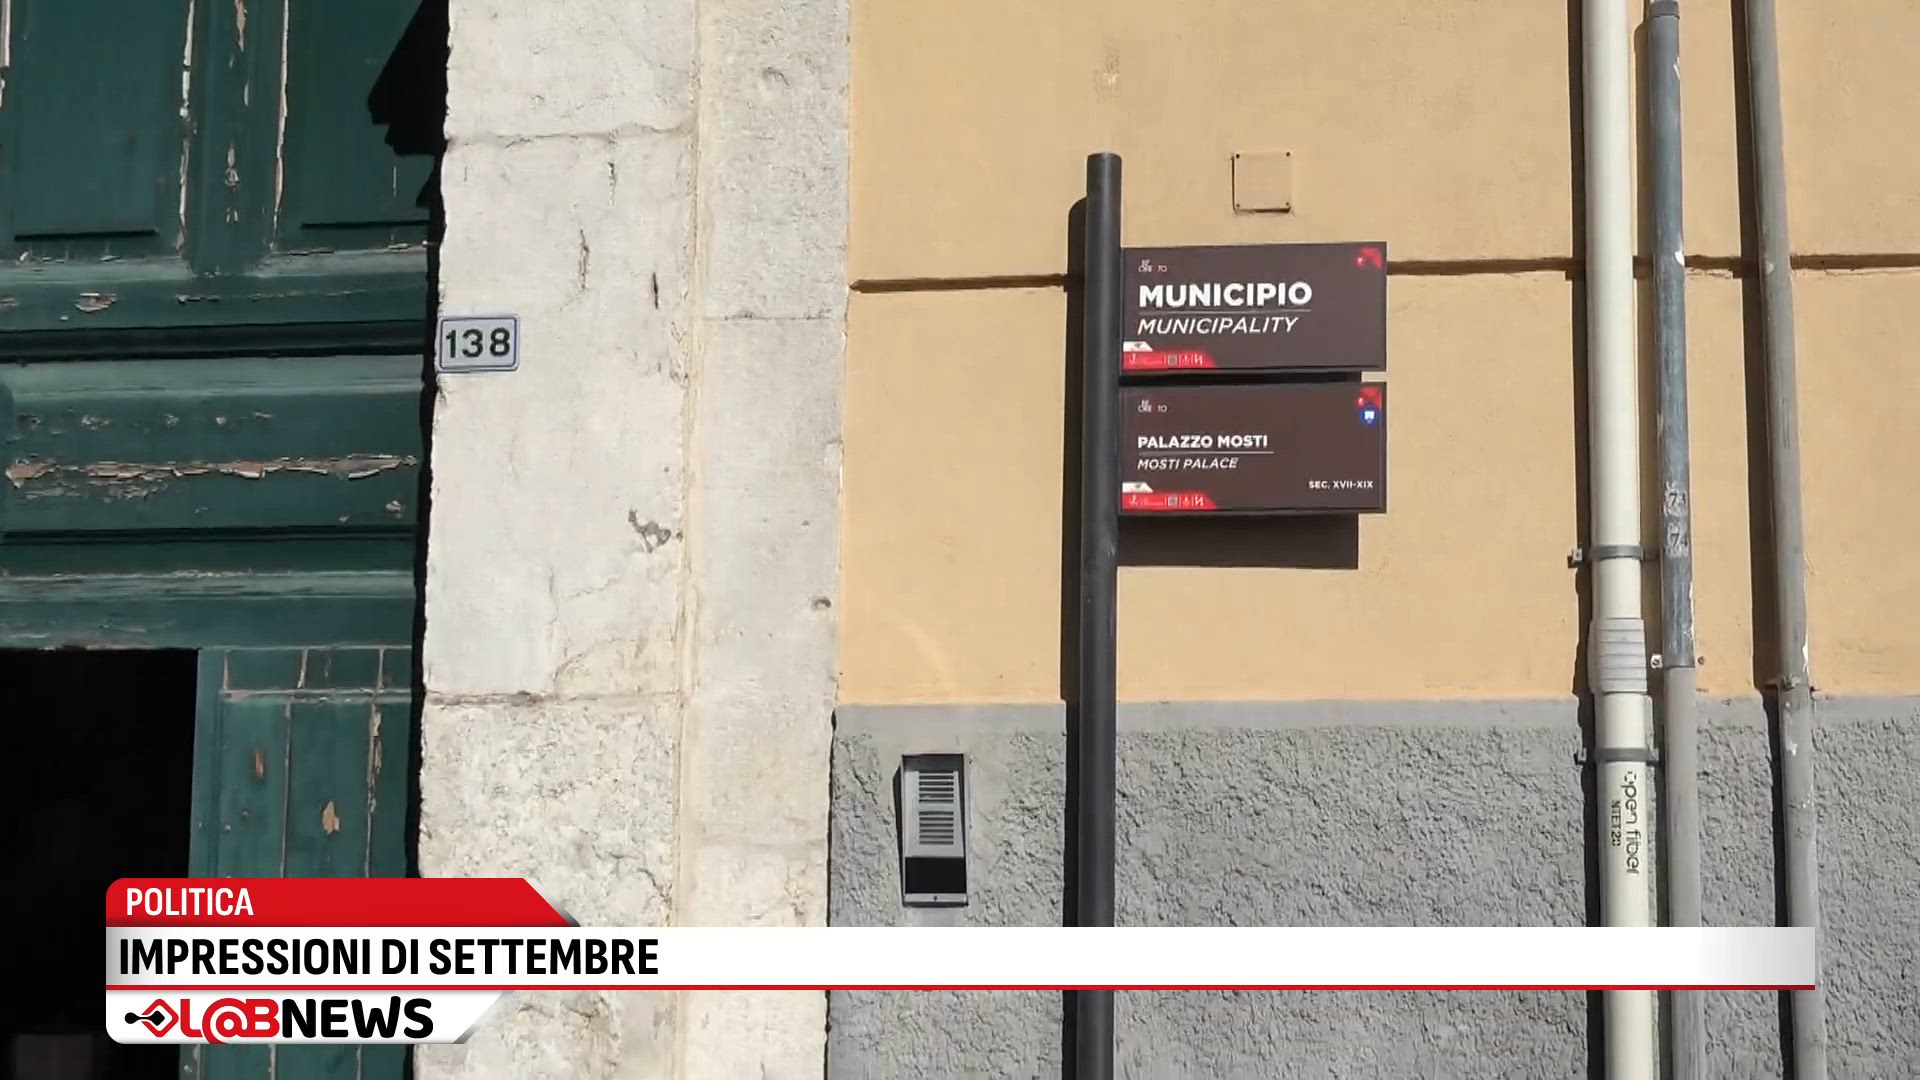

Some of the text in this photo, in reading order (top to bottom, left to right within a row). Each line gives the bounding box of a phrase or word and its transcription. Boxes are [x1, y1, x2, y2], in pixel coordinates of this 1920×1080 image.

[1138, 281, 1313, 308] MUNICIPIO
[1137, 316, 1299, 335] MUNICIPALITY
[446, 327, 510, 358] 138
[1137, 434, 1268, 449] PALAZZO MOSTI
[1137, 457, 1239, 470] MOSTI PALACE
[1308, 479, 1374, 489] SEC. XVII-XIX
